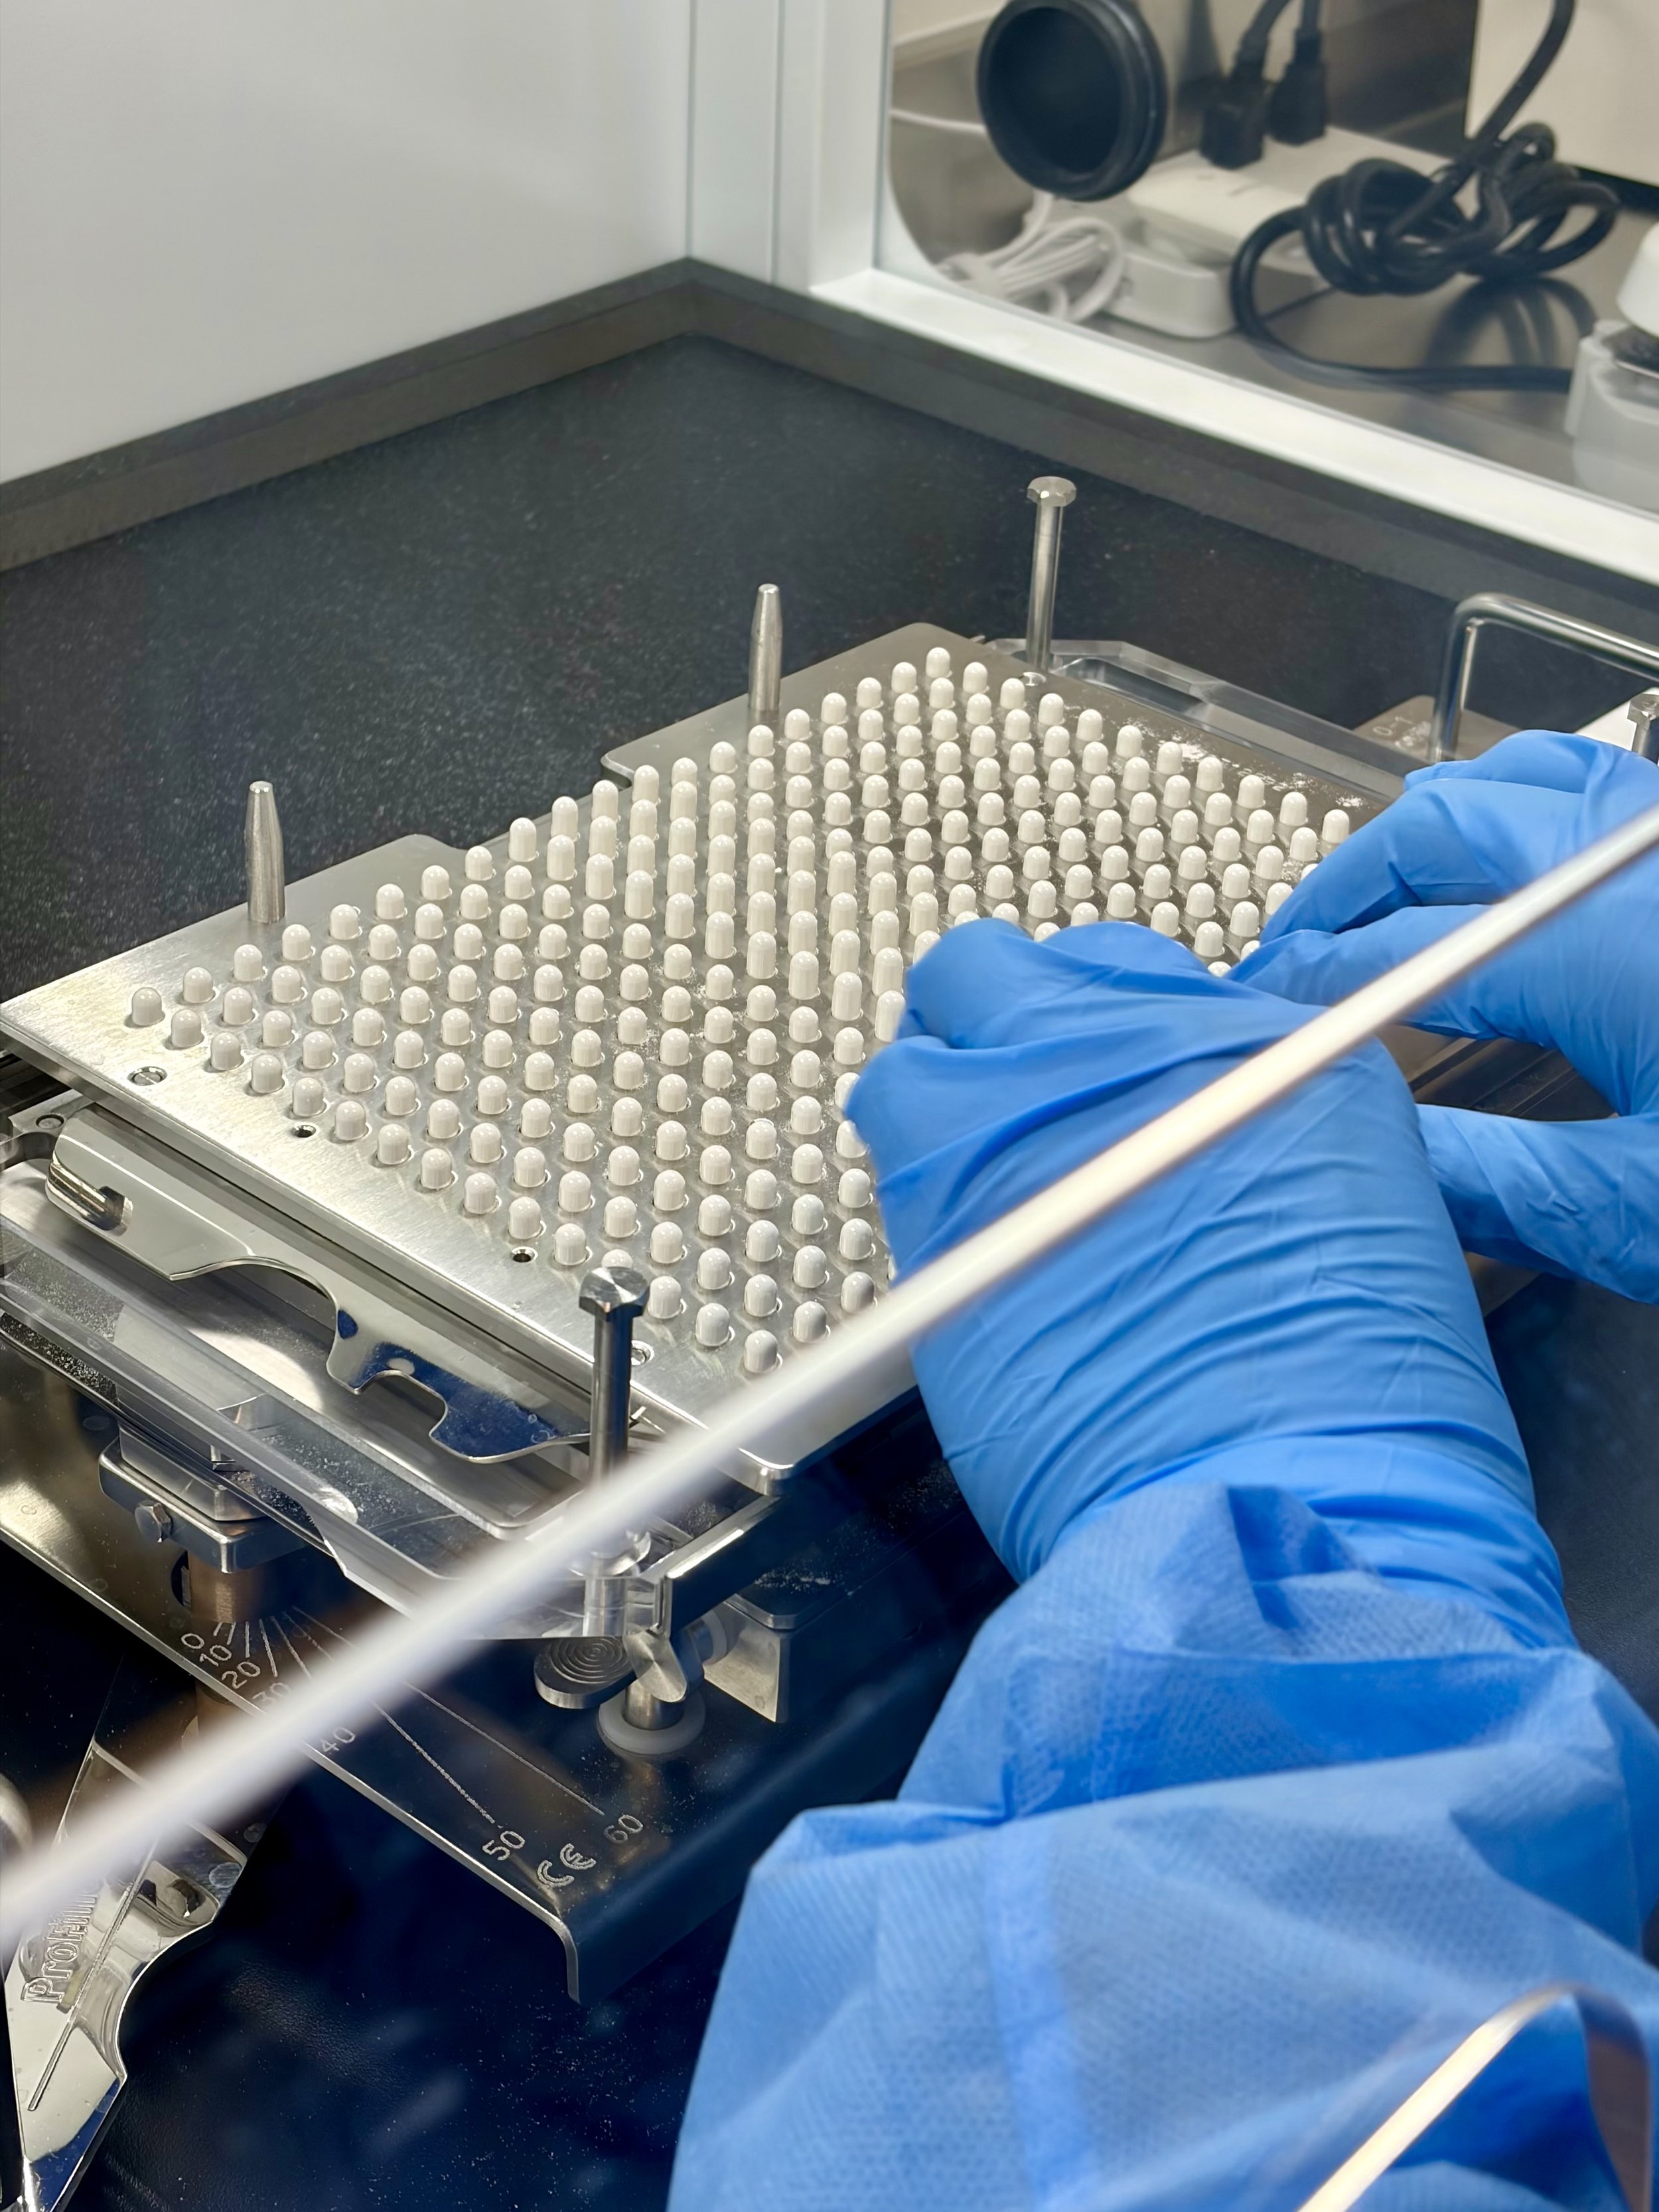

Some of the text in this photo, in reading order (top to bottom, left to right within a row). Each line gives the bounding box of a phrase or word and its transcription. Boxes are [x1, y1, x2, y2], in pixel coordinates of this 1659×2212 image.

[181, 1633, 205, 1649] 0
[200, 1645, 232, 1666] 10
[222, 1661, 261, 1689] 20
[252, 1682, 291, 1706] 30
[322, 1726, 356, 1752] 40
[604, 1814, 643, 1844] 60
[482, 1830, 526, 1860] 50
[537, 1844, 596, 1887] CE
